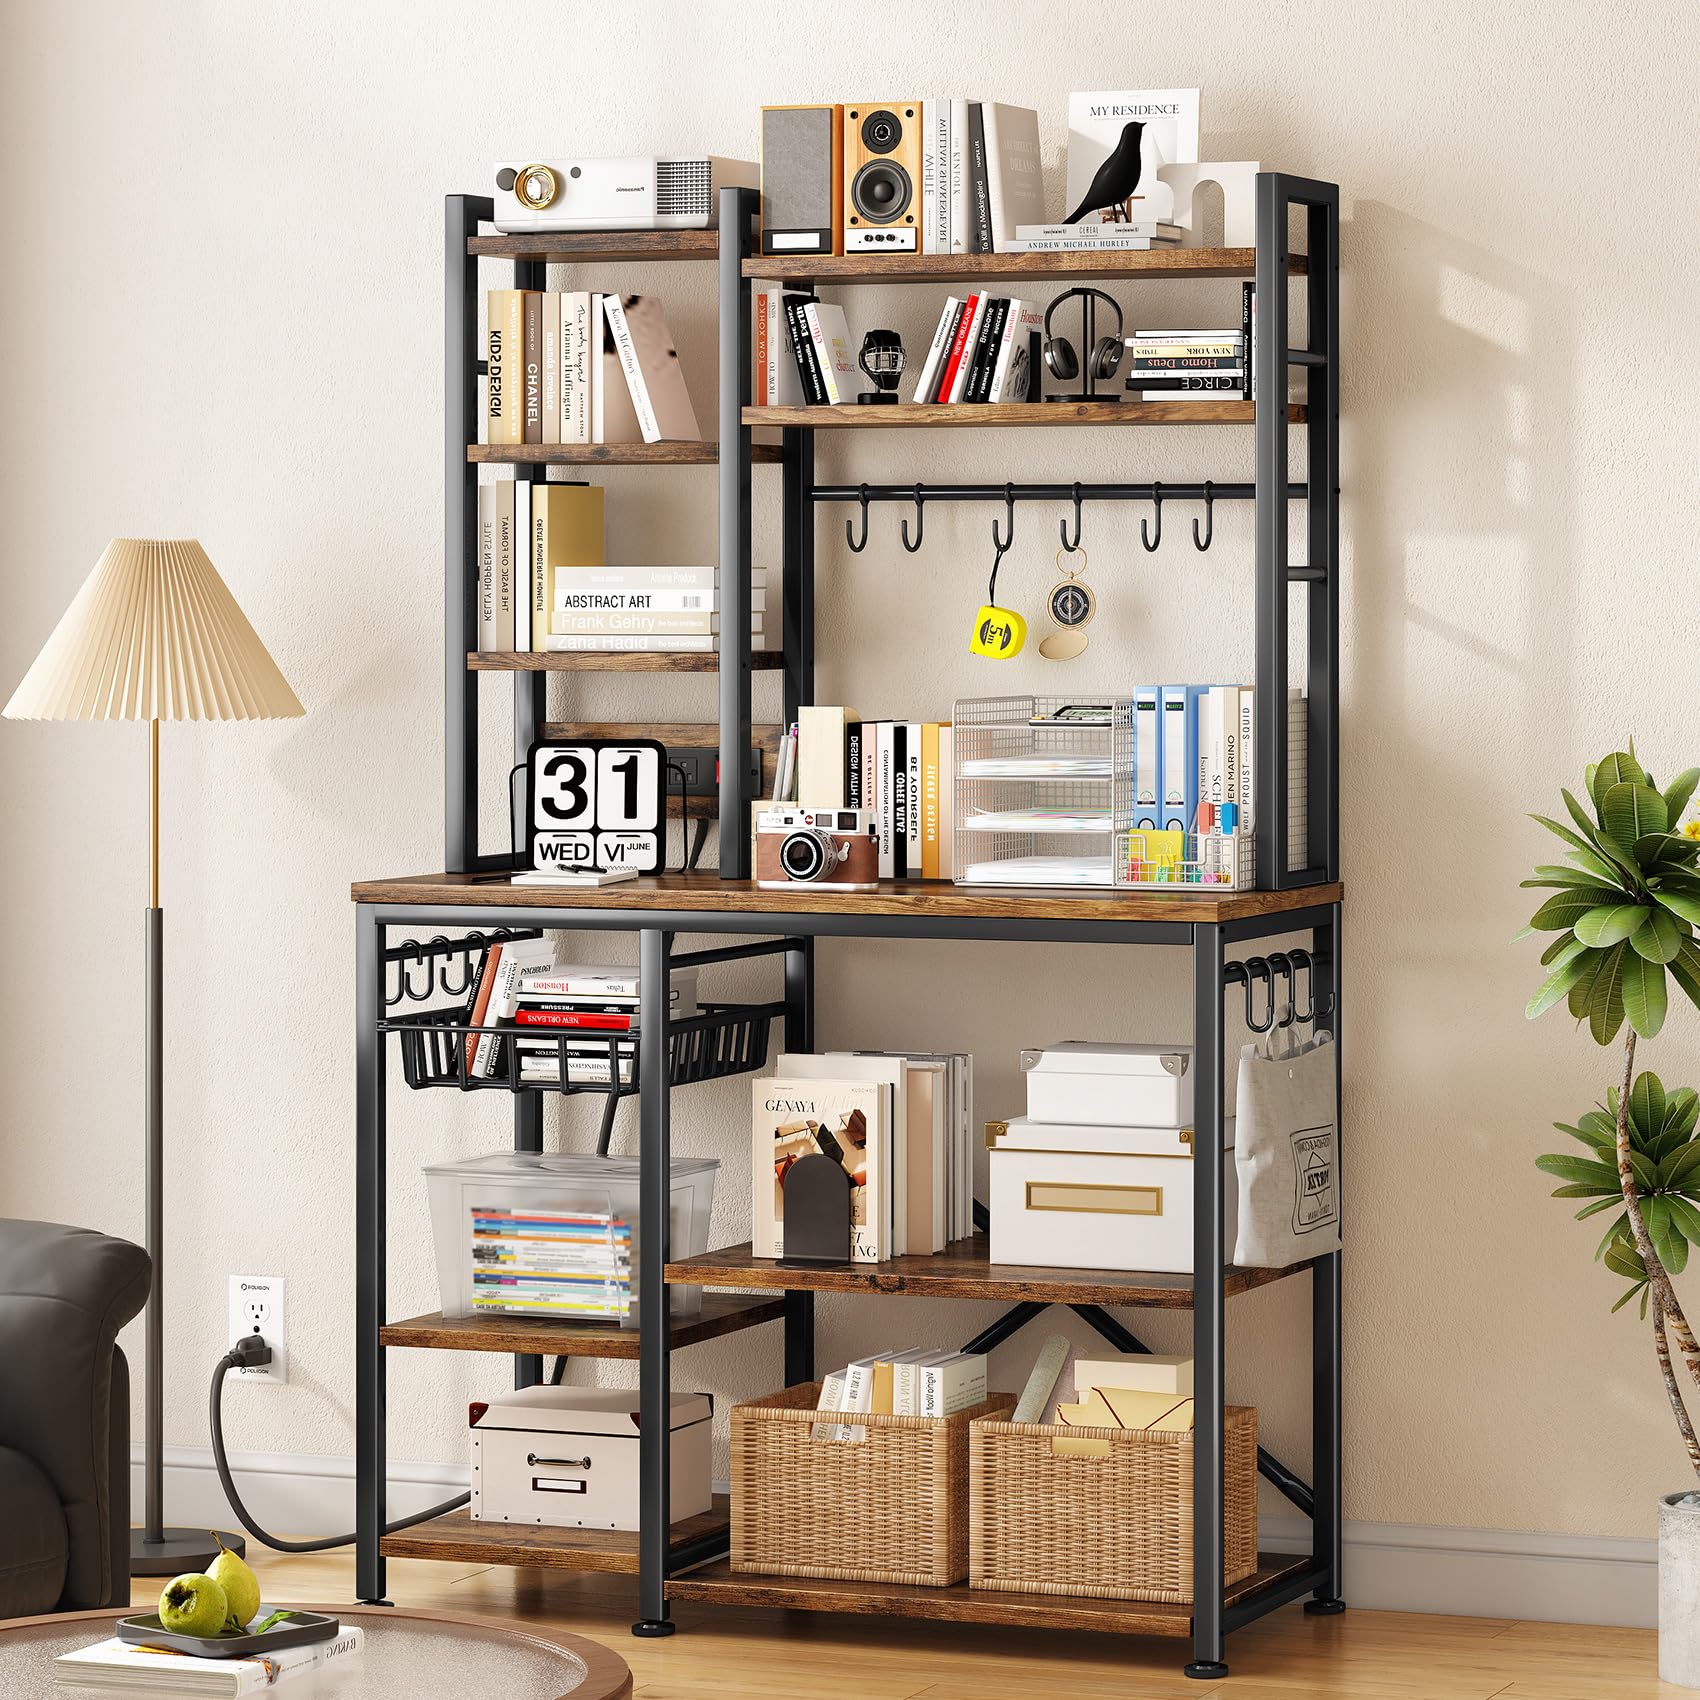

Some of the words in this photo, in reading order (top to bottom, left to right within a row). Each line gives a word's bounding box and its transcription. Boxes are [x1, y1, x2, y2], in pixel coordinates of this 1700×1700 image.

[1090, 106, 1109, 117] MY
[1112, 103, 1180, 116] RESIDENCE
[953, 151, 961, 195] KINFOLK
[977, 180, 987, 223] Mockingbird
[980, 230, 988, 241] Kill
[1079, 226, 1099, 235] CEREAL
[981, 242, 989, 251] To
[1027, 241, 1061, 249] ANDREW
[1063, 240, 1096, 249] MICHAEL
[1099, 240, 1130, 248] HURLEY
[611, 308, 623, 331] Karen
[787, 305, 795, 325] IDEA
[564, 320, 573, 360] Arianna
[954, 342, 962, 356] NEW
[958, 306, 973, 339] ORLEANS
[967, 366, 979, 396] Queensland
[979, 307, 994, 344] Brisbane
[980, 366, 991, 394] FORMULA
[994, 308, 1004, 335] SUCCESS
[1213, 347, 1232, 355] NEW
[1147, 358, 1176, 369] Deus
[1181, 358, 1218, 368] Homo
[563, 364, 573, 420] Huffington
[1180, 377, 1233, 389] CIRCE
[527, 363, 538, 426] CHANEL
[564, 595, 625, 608] ABSTRACT
[628, 595, 652, 608] ART
[561, 613, 605, 630] Frank
[609, 613, 656, 633] Gehry
[987, 624, 1004, 645] 5m
[1242, 707, 1250, 740] SQUID
[1227, 734, 1235, 781] MARINO
[1242, 763, 1250, 805] PROUST
[539, 843, 590, 861] WED
[604, 843, 625, 862] VI
[626, 842, 651, 851] JUNE
[520, 964, 551, 976] PSYCHOLOGY
[466, 966, 483, 1011] WASHINGTON
[533, 981, 569, 992] Houston
[527, 1015, 562, 1023] ORLEANS
[476, 1040, 487, 1064] HOW
[765, 1099, 815, 1113] GENAYA
